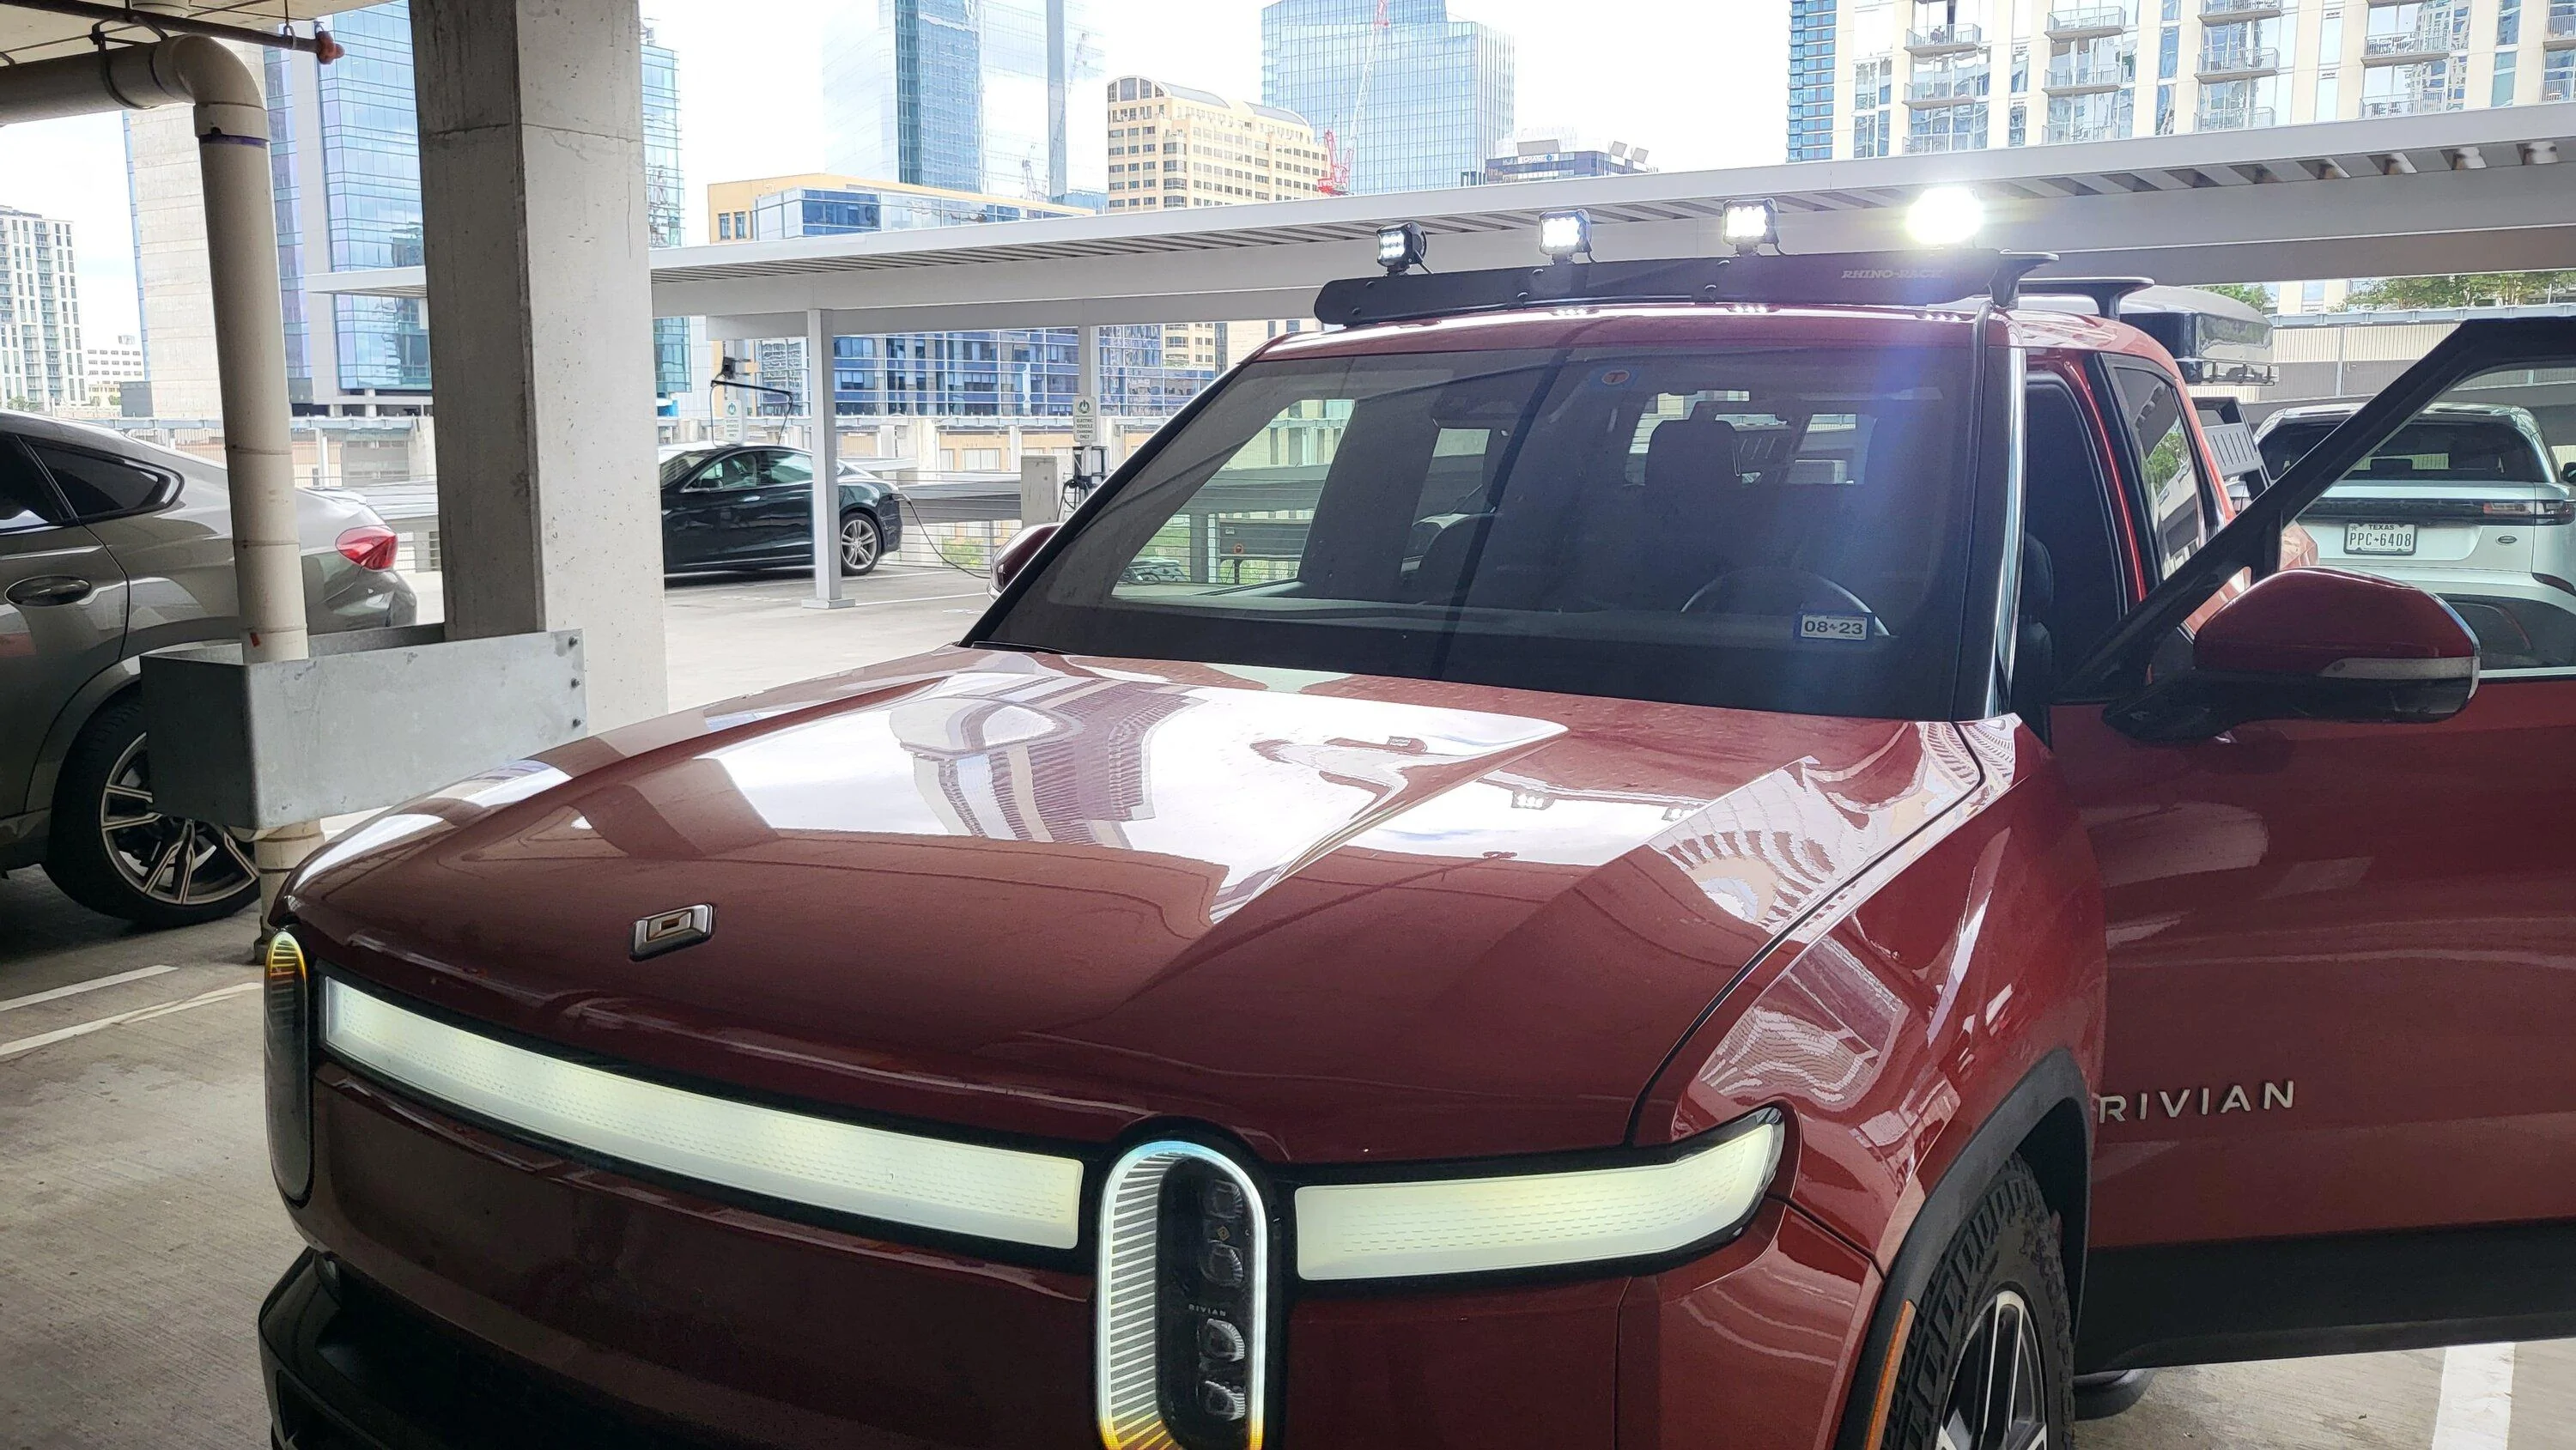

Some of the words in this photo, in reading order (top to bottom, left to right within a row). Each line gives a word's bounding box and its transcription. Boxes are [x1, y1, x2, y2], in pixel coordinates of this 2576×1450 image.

[1841, 269, 1943, 279] RHINO-RACK
[2099, 1080, 2294, 1124] RIVIAN
[1188, 1303, 1226, 1317] RIVIAN
